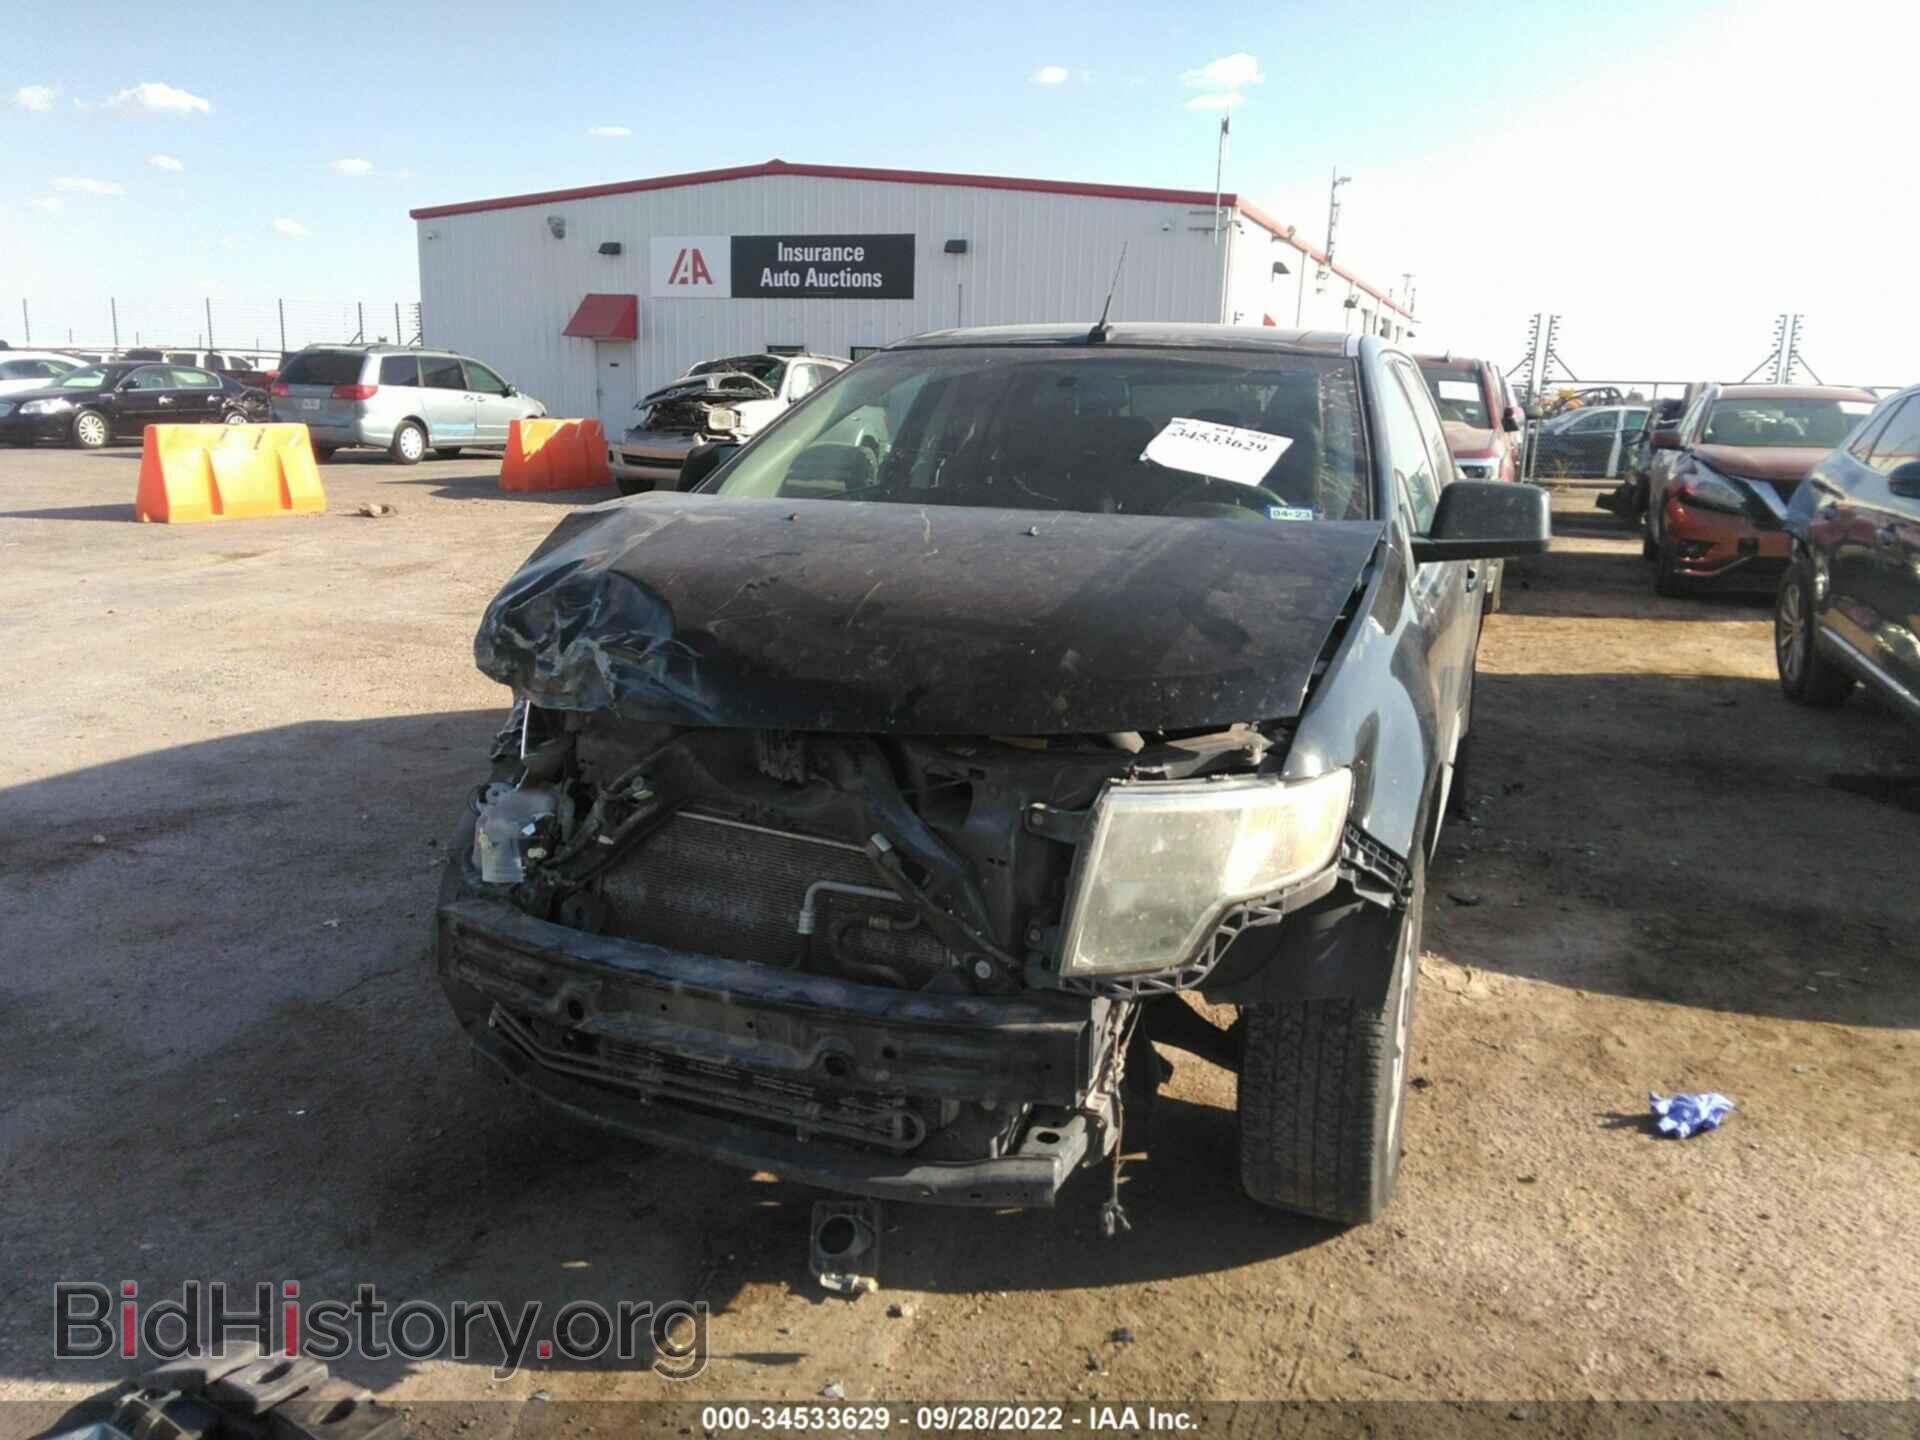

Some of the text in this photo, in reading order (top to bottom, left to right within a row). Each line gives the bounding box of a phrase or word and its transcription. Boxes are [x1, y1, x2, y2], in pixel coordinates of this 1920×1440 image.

[777, 241, 865, 263] Insurance
[760, 267, 882, 288] Auto Auctions
